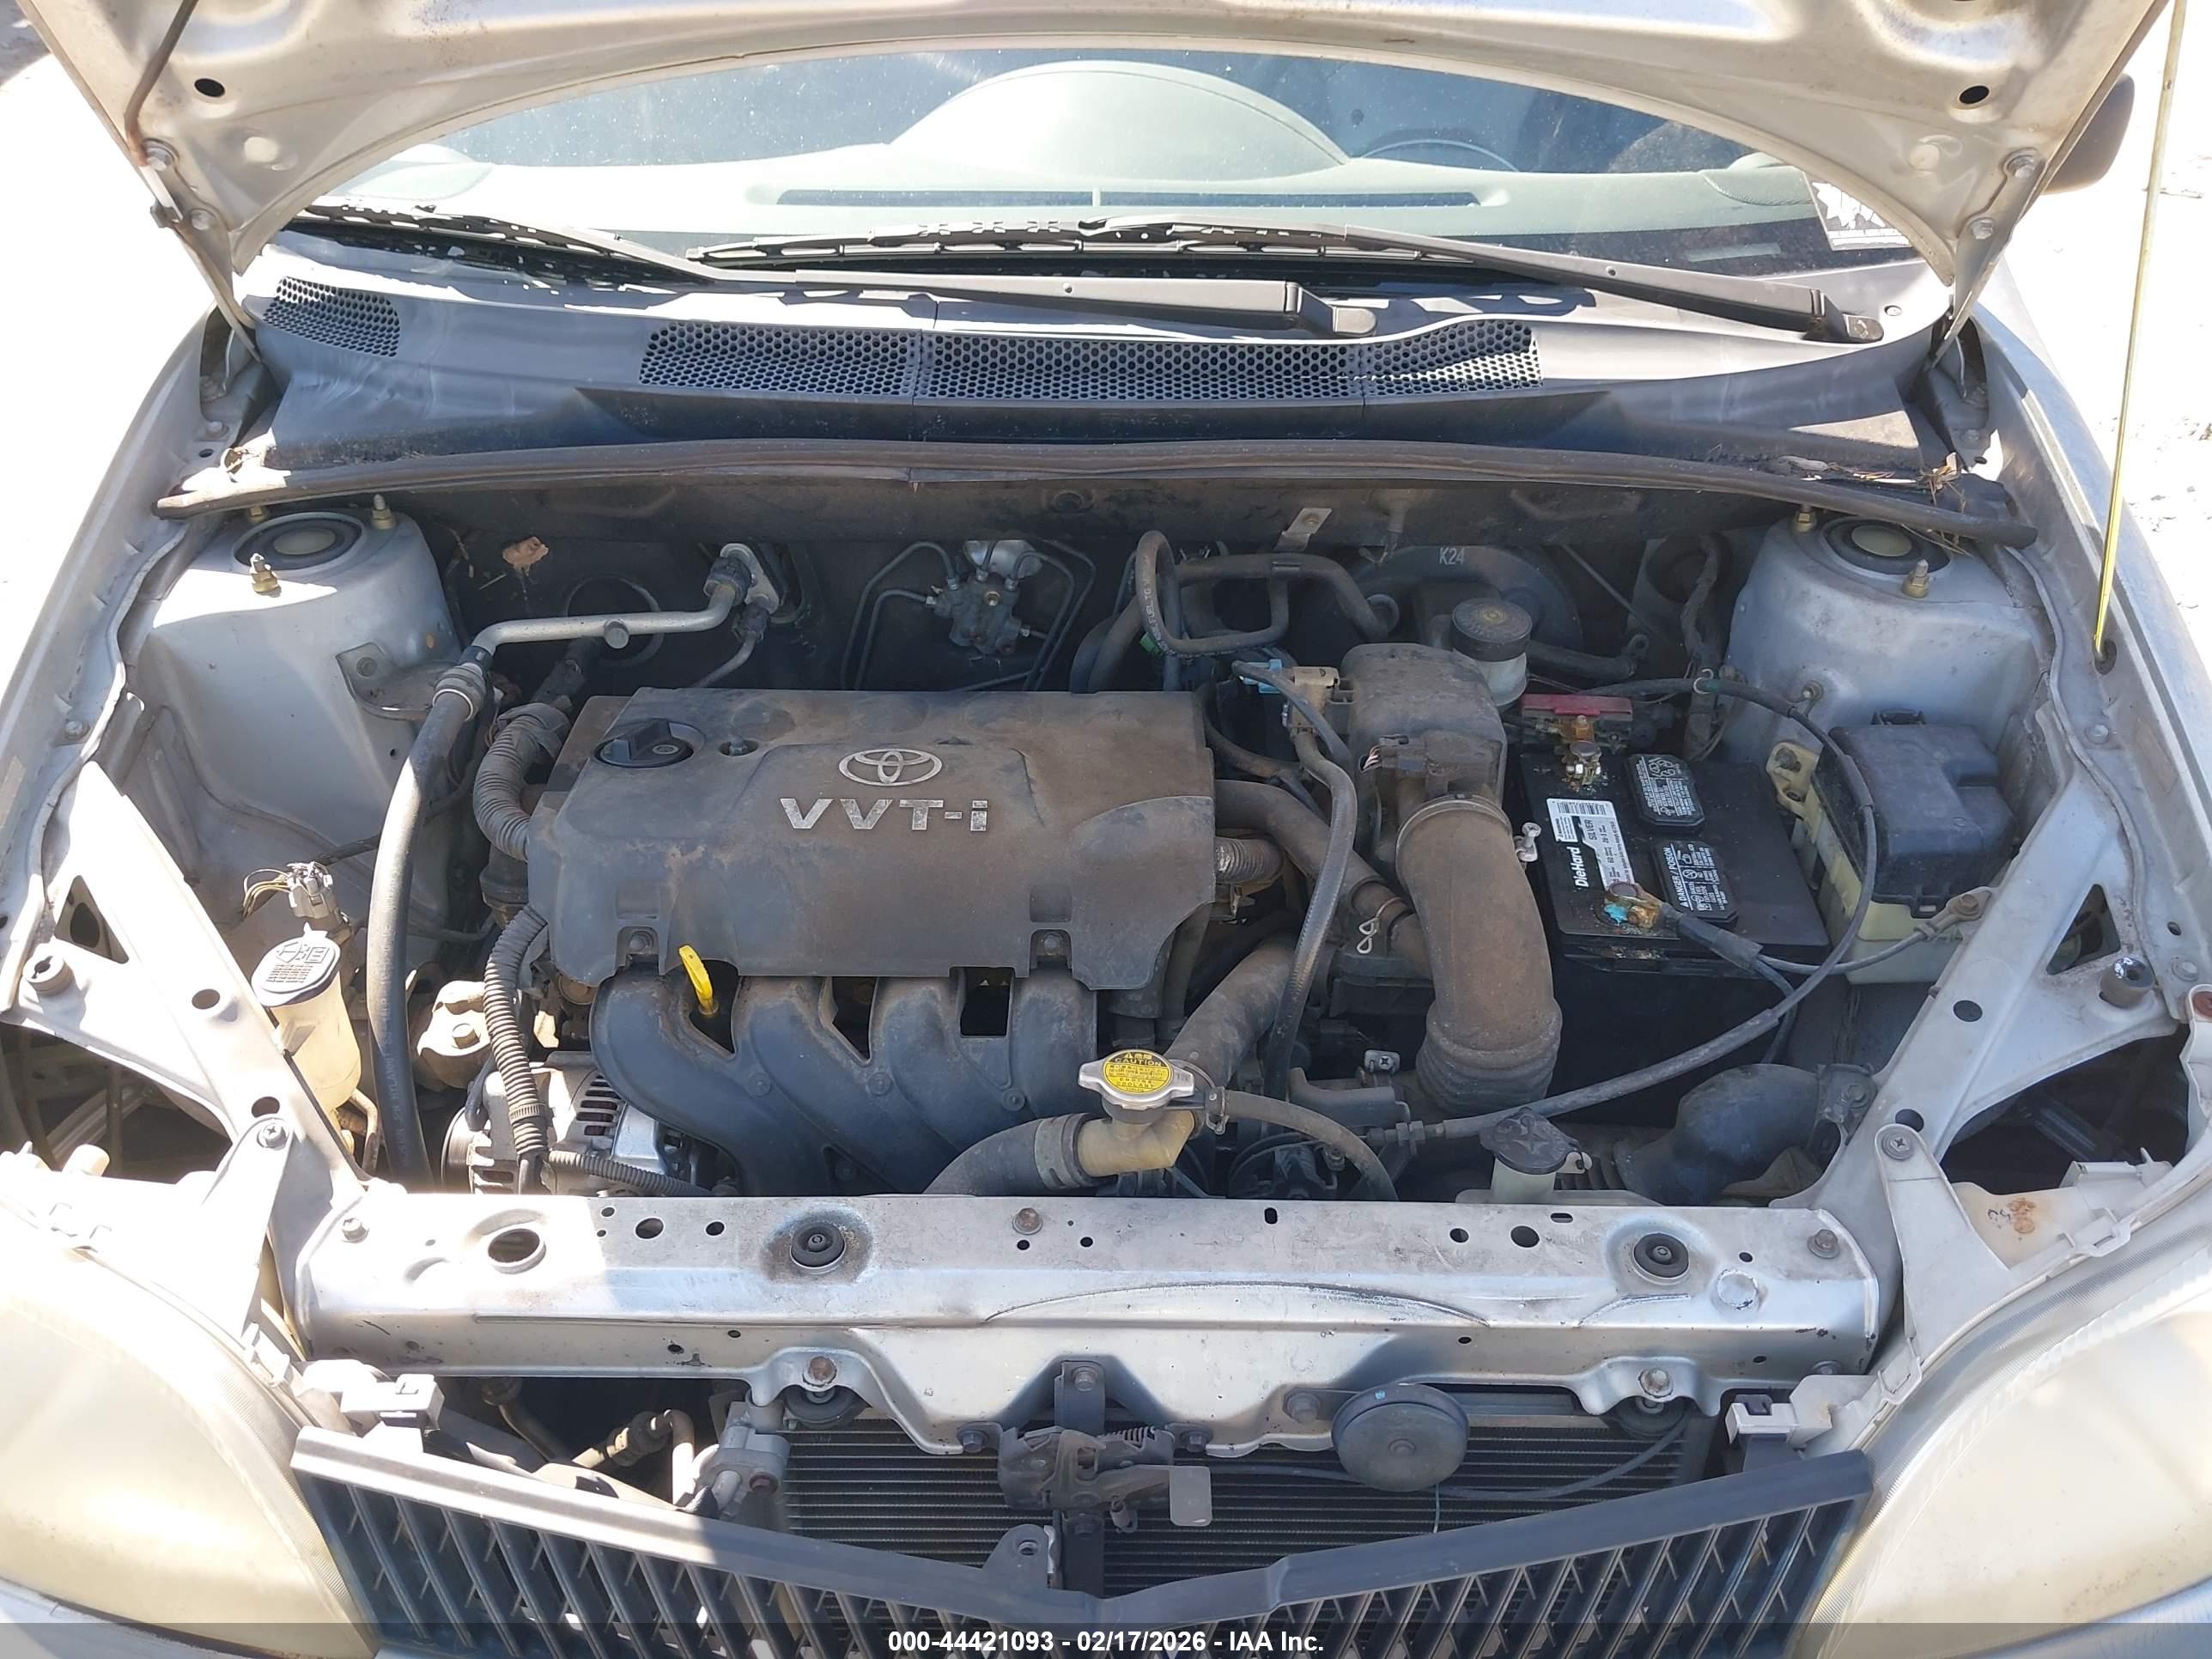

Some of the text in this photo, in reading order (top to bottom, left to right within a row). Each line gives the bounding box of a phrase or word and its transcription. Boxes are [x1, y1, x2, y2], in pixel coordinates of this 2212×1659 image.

[1439, 546, 1465, 565] K24
[779, 798, 988, 831] VVT-i
[1584, 819, 1597, 841] SILVER
[1566, 846, 1589, 888] DieHard
[1662, 847, 1678, 870] POISON
[1672, 876, 1687, 902] DANGER
[1115, 1057, 1162, 1066] CAUTION
